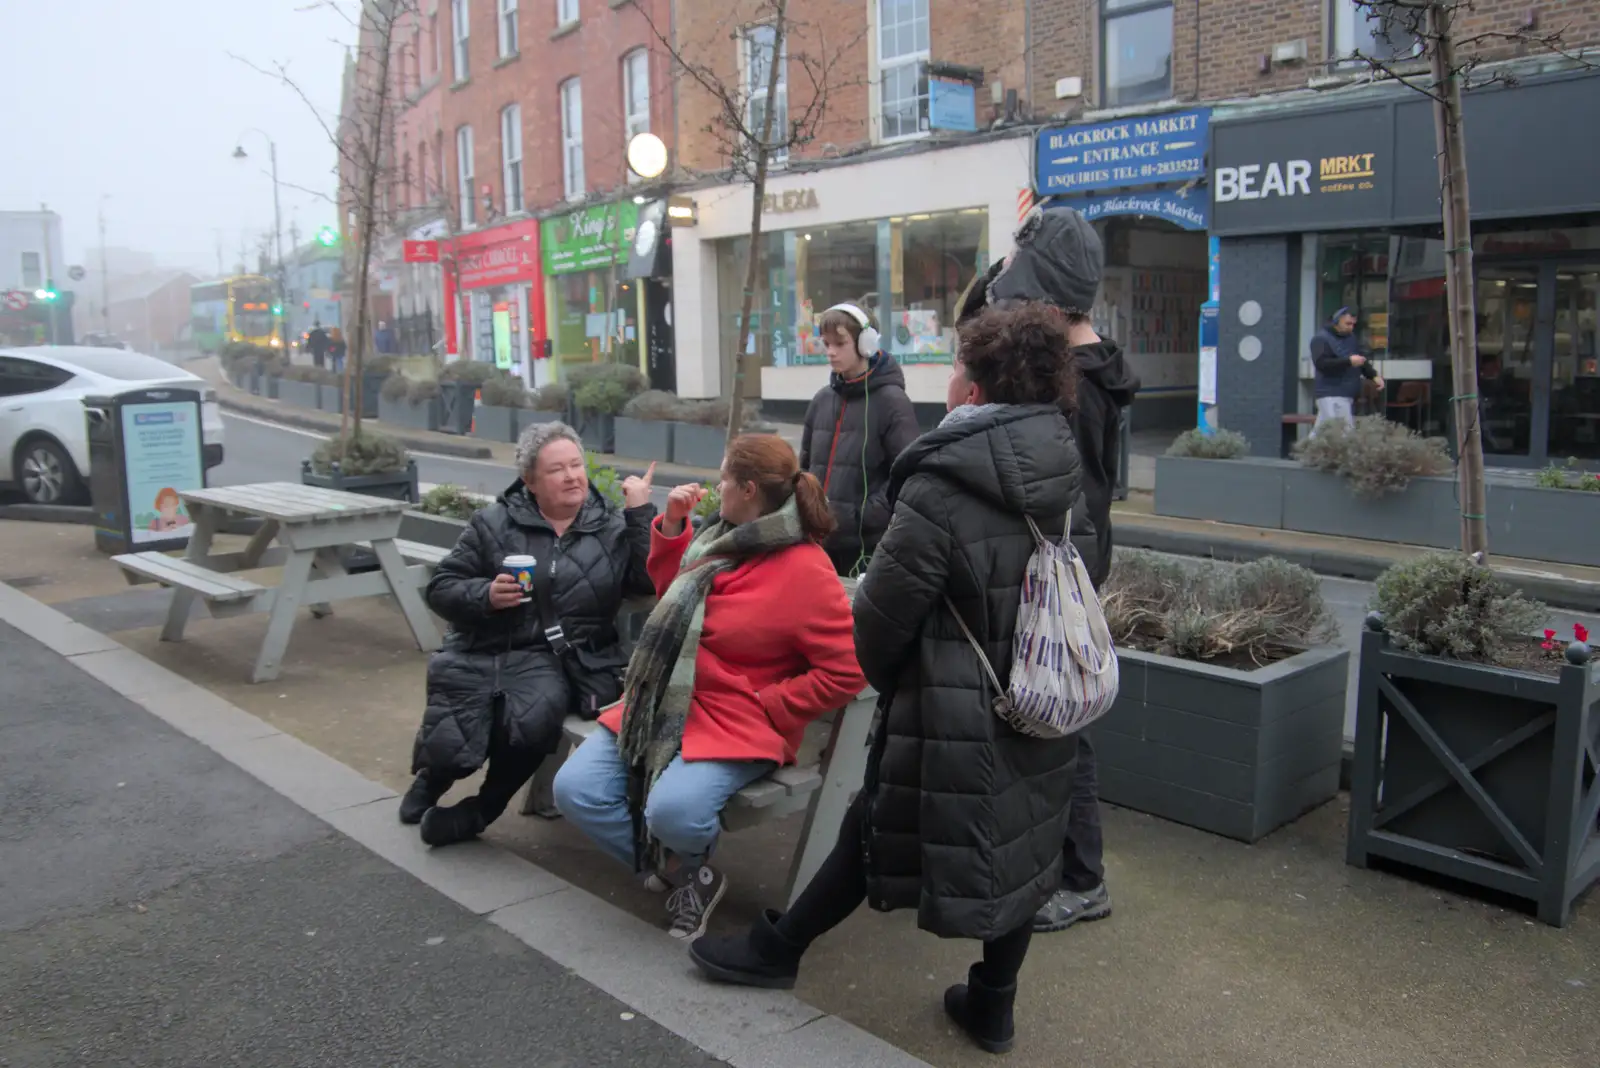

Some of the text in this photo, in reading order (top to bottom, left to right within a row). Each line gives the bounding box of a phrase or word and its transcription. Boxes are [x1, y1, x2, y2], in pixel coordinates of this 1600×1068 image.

[1050, 114, 1198, 149] BLACKROCK MARKET
[1083, 141, 1159, 164] ENTRANCE
[1047, 169, 1109, 188] ENQUIRIES
[1215, 153, 1375, 202] BEAR MRKT
[1089, 203, 1101, 216] to
[1103, 196, 1160, 213] Blackrock
[1163, 201, 1204, 225] Market
